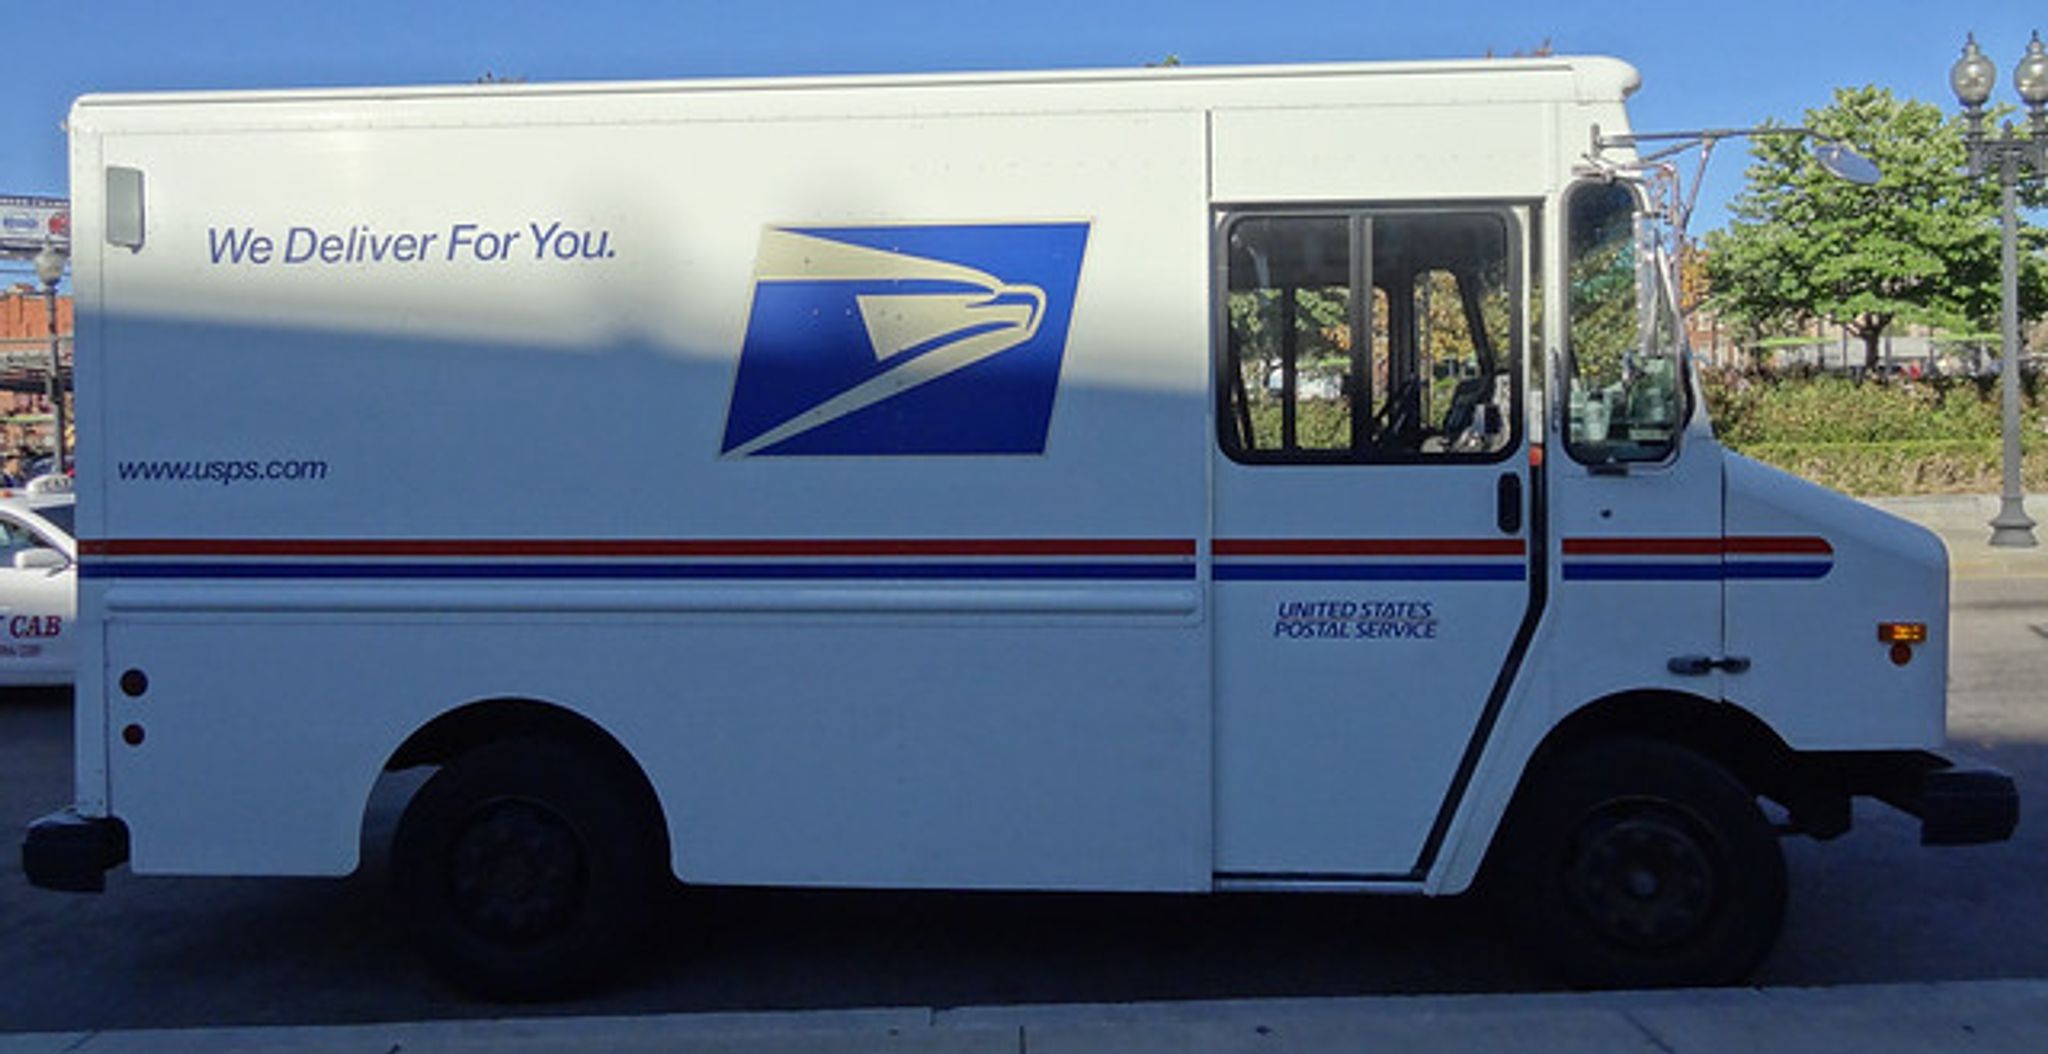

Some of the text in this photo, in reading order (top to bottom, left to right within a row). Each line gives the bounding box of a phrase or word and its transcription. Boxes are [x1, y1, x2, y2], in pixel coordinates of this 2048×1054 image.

[208, 221, 616, 265] We Deliver For You.
[118, 460, 328, 485] www.usps.com
[1278, 602, 1434, 618] UNITED STATES
[9, 615, 62, 639] CAB
[1274, 621, 1438, 639] POSTAL SERVICE
